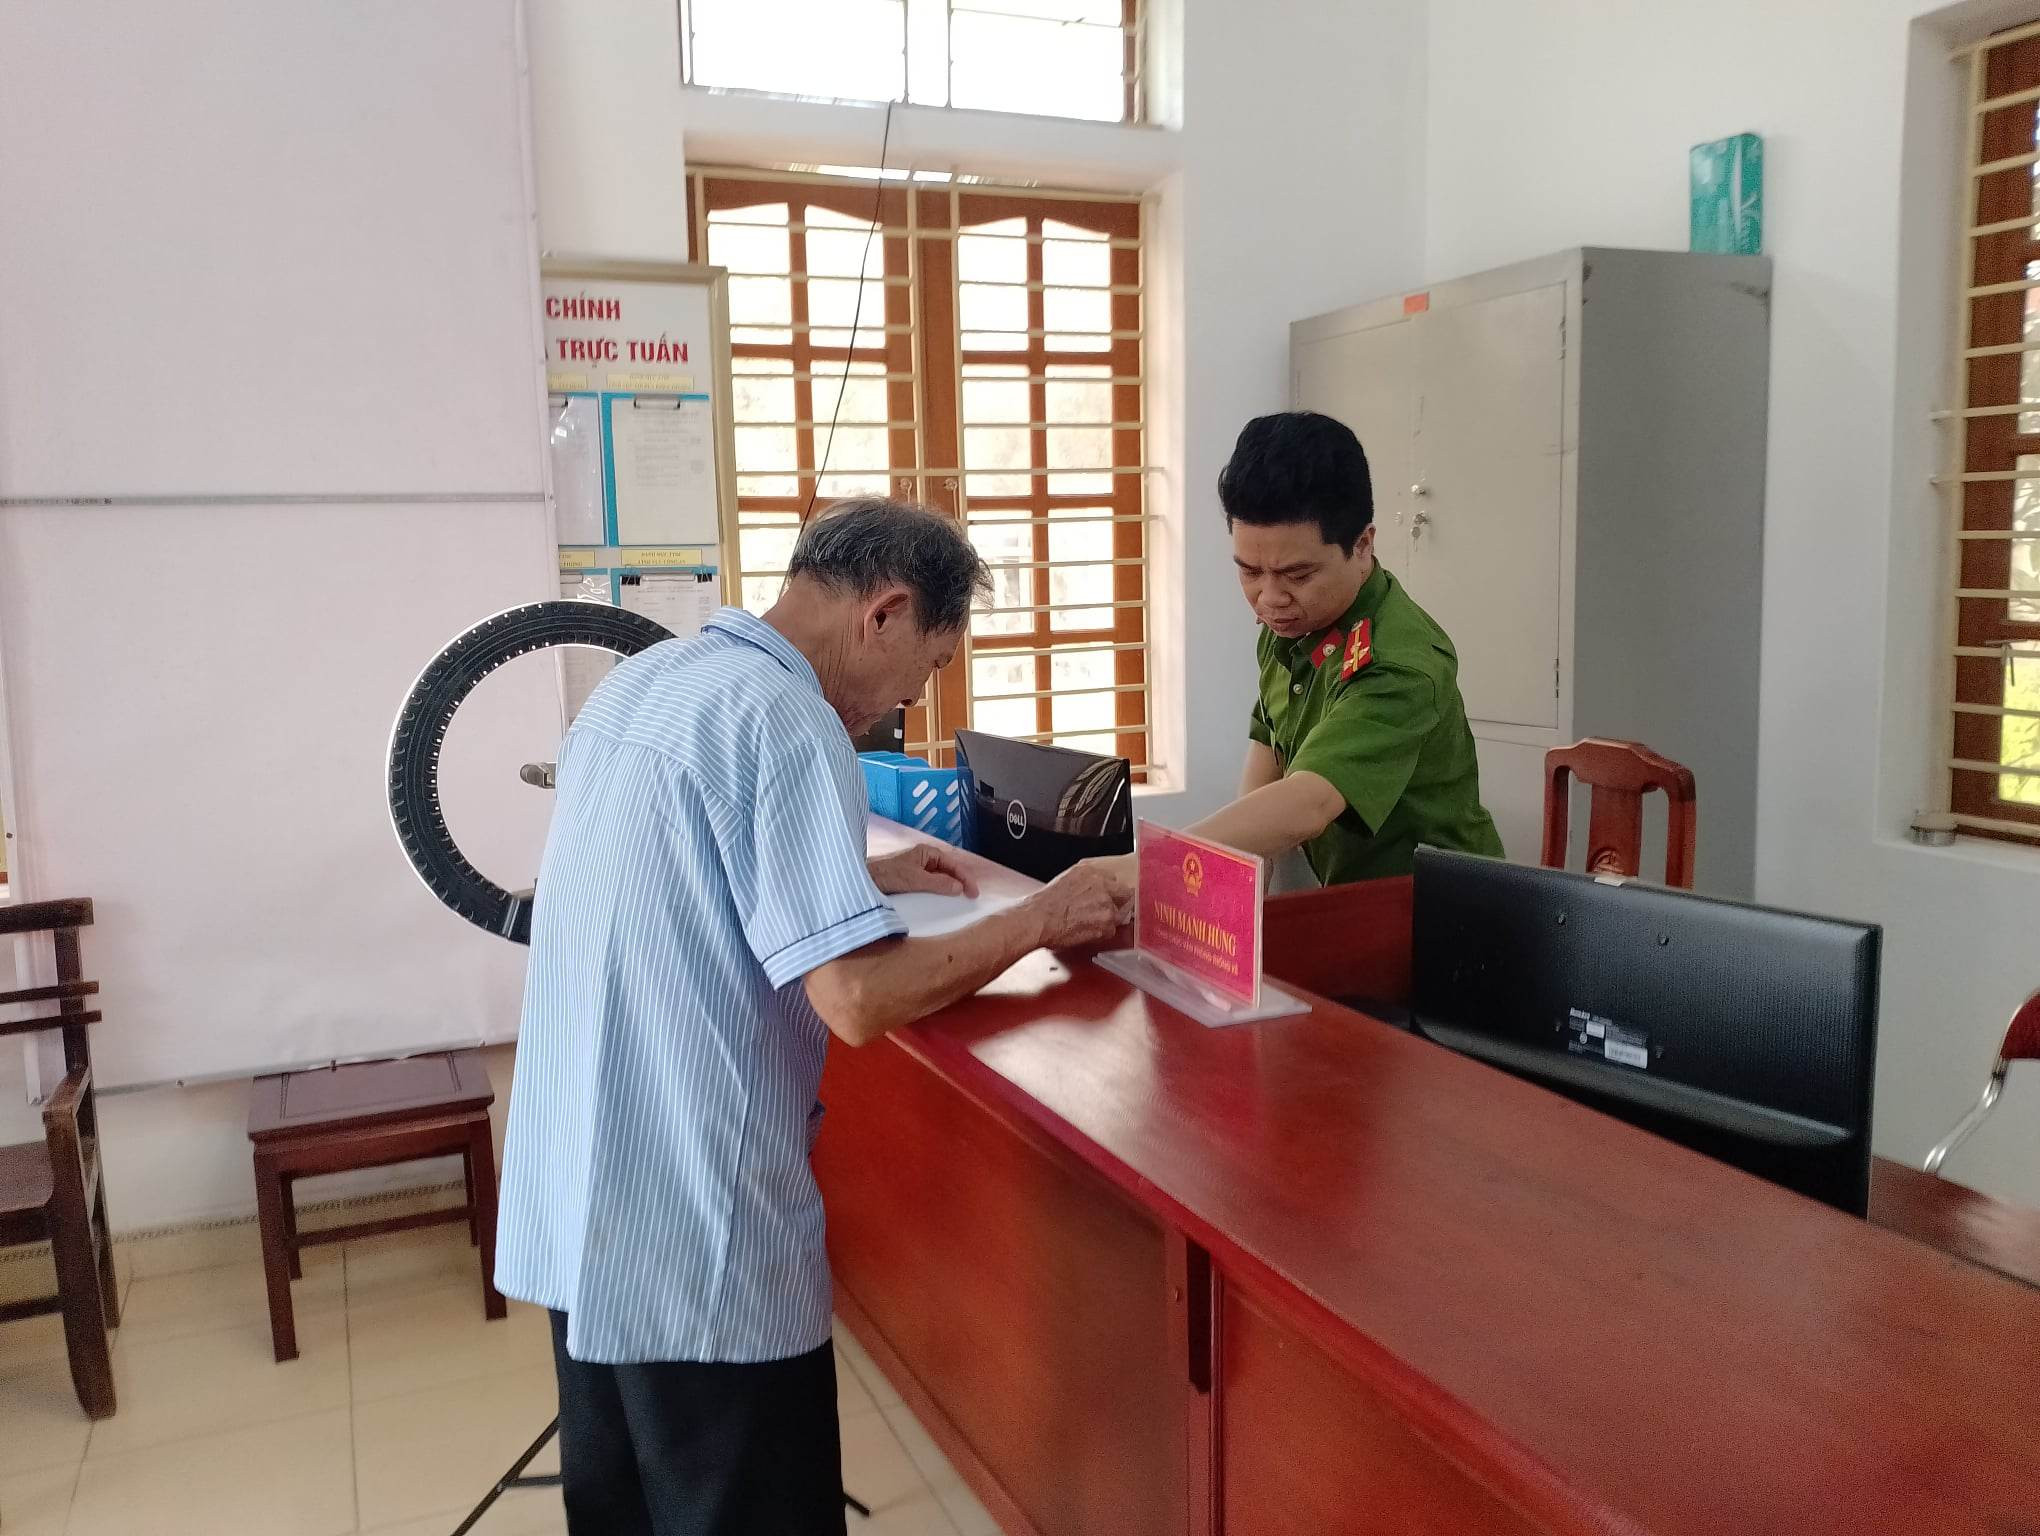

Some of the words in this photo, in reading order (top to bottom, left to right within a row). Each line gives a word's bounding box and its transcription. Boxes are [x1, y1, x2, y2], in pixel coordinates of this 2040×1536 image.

[545, 291, 621, 321] CHÍNH
[556, 336, 619, 369] TRỰC
[1009, 812, 1025, 827] DELL
